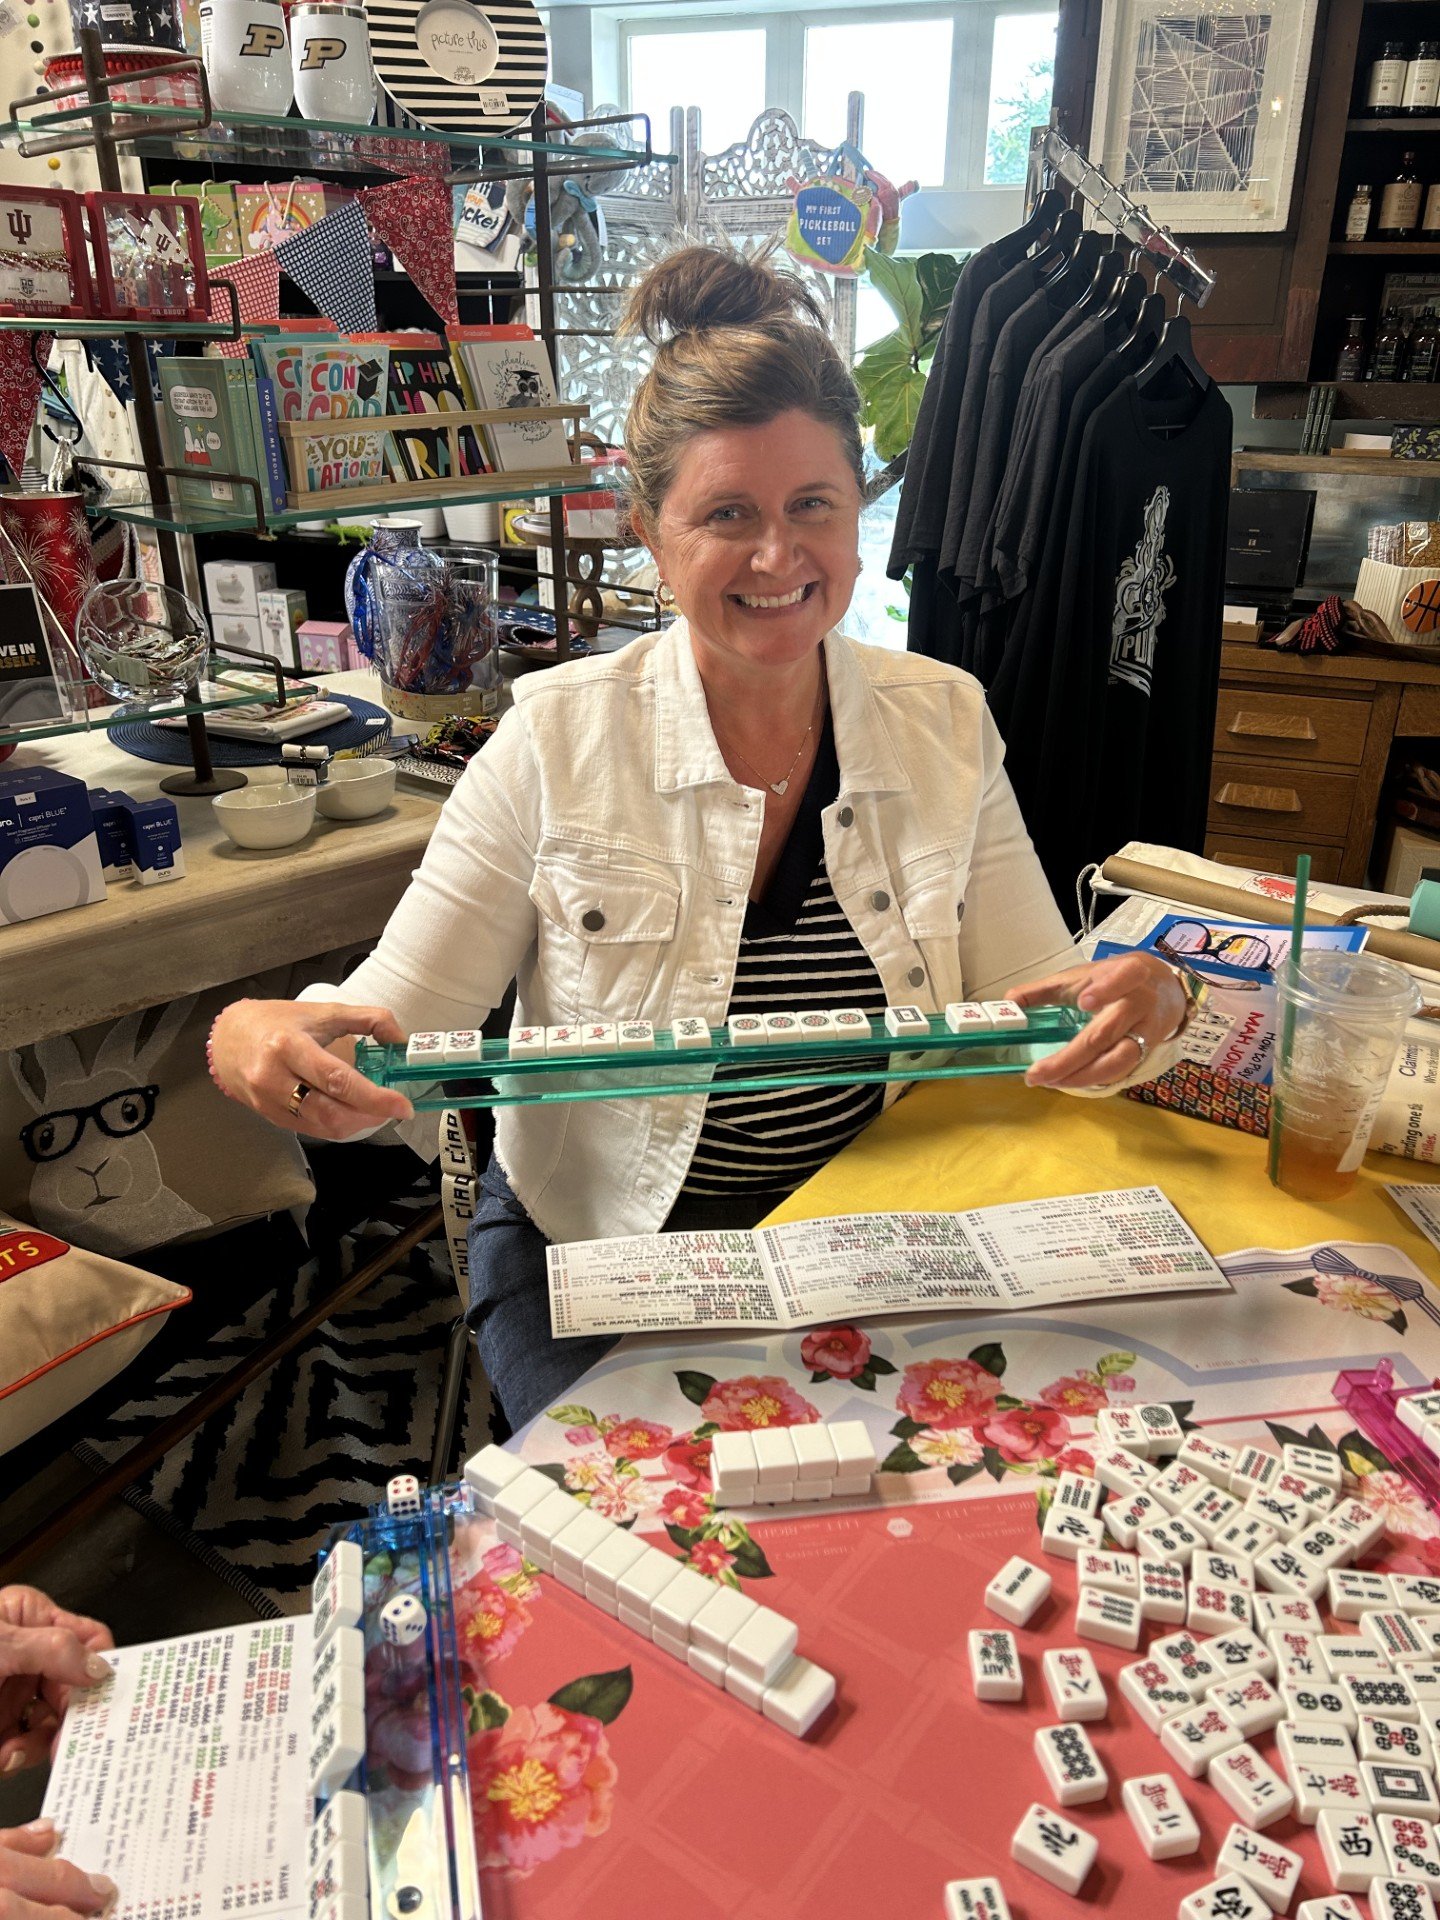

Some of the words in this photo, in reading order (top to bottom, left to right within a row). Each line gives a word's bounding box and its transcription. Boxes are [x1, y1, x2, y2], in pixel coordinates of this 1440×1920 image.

[240, 23, 285, 58] P
[431, 31, 465, 52] picture
[299, 38, 347, 71] P
[805, 205, 817, 214] MY
[819, 205, 841, 215] FIRST
[799, 218, 856, 232] PICKLEBALL
[816, 236, 832, 246] SET
[269, 438, 276, 448] ME
[316, 435, 367, 460] YOU
[271, 452, 279, 481] PROUD
[19, 643, 36, 655] IN
[28, 812, 45, 823] capri
[143, 823, 155, 831] capri
[1239, 1011, 1265, 1045] MAH
[1262, 1031, 1276, 1053] How
[1215, 1045, 1242, 1079] JONG
[1254, 1053, 1267, 1065] to
[1238, 1063, 1262, 1081] Play
[1411, 1110, 1423, 1128] one
[445, 1112, 467, 1164] CIAO
[0, 1240, 40, 1271] TS
[282, 1645, 292, 1669] 2025
[278, 1693, 289, 1713] 222
[103, 1739, 115, 1757] ANY
[287, 1733, 297, 1756] 2025
[99, 1759, 111, 1778] LIKE
[90, 1779, 107, 1825] NUMBERS
[1339, 1826, 1373, 1858] 西
[279, 1863, 290, 1900] VALUES
